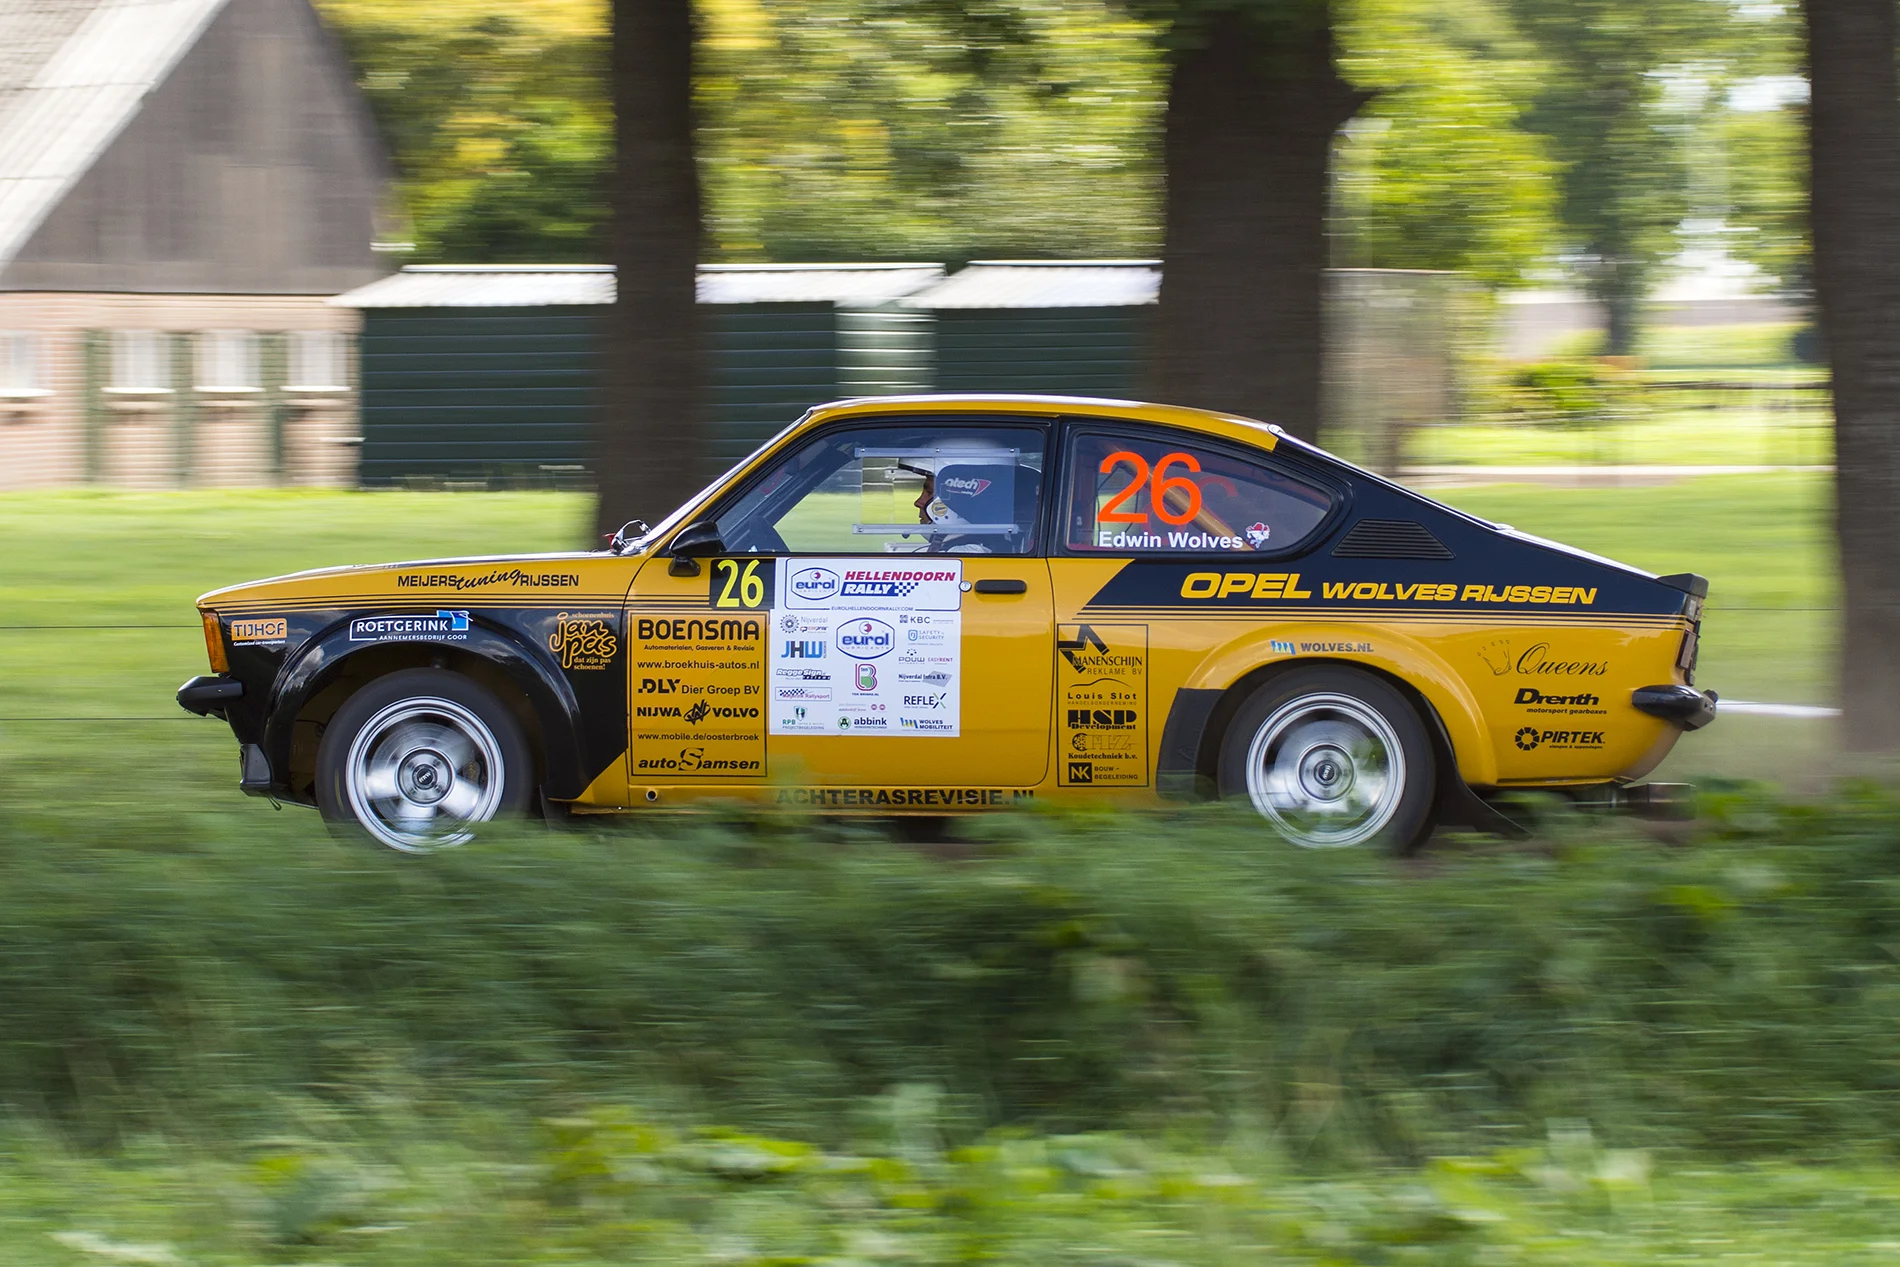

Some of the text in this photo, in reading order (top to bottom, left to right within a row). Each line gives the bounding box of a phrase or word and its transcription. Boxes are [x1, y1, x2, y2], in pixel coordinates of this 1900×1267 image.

[1097, 451, 1202, 525] 26
[1099, 531, 1243, 549] Edwin Wolves
[398, 569, 579, 590] MEIJERS tuning RIJSSEN
[844, 571, 956, 582] HELLENDOORN
[716, 559, 764, 608] 26
[795, 579, 835, 590] eurol
[844, 583, 892, 595] RALLY
[1180, 572, 1598, 605] OPEL WOLVES RIJSSEN
[356, 620, 449, 632] ROETGERINK
[801, 616, 828, 624] Nijverdal
[910, 616, 931, 624] KBC
[233, 622, 285, 637] TIJHOF
[549, 612, 608, 652] jan
[638, 619, 760, 640] BOENSMA
[842, 633, 890, 646] eurol
[562, 636, 617, 669] pas
[781, 640, 823, 658] JHW
[1300, 642, 1374, 653] WOLVES.NL
[586, 656, 599, 664] zijn
[637, 660, 760, 669] www.broekhuis-autos.nl
[1072, 655, 1143, 668] MANENSCHIJN
[1516, 642, 1609, 676] Queens
[1087, 667, 1143, 675] REKLAME BV
[681, 685, 704, 695] Dier
[707, 685, 741, 696] Groep
[744, 685, 760, 695] BV
[1067, 692, 1137, 700] Louis Slot
[1514, 688, 1600, 706] Drenth
[637, 707, 760, 718] NIJWA VOLVO
[1526, 707, 1568, 715] motorsport
[853, 717, 888, 726] abbink
[1071, 723, 1136, 731] Development
[637, 733, 760, 741] www.mobile.de/oosterbroek
[1540, 730, 1605, 744] PIRTEK
[1068, 752, 1138, 760] Koudetechniek b.v.
[1070, 766, 1091, 780] NK
